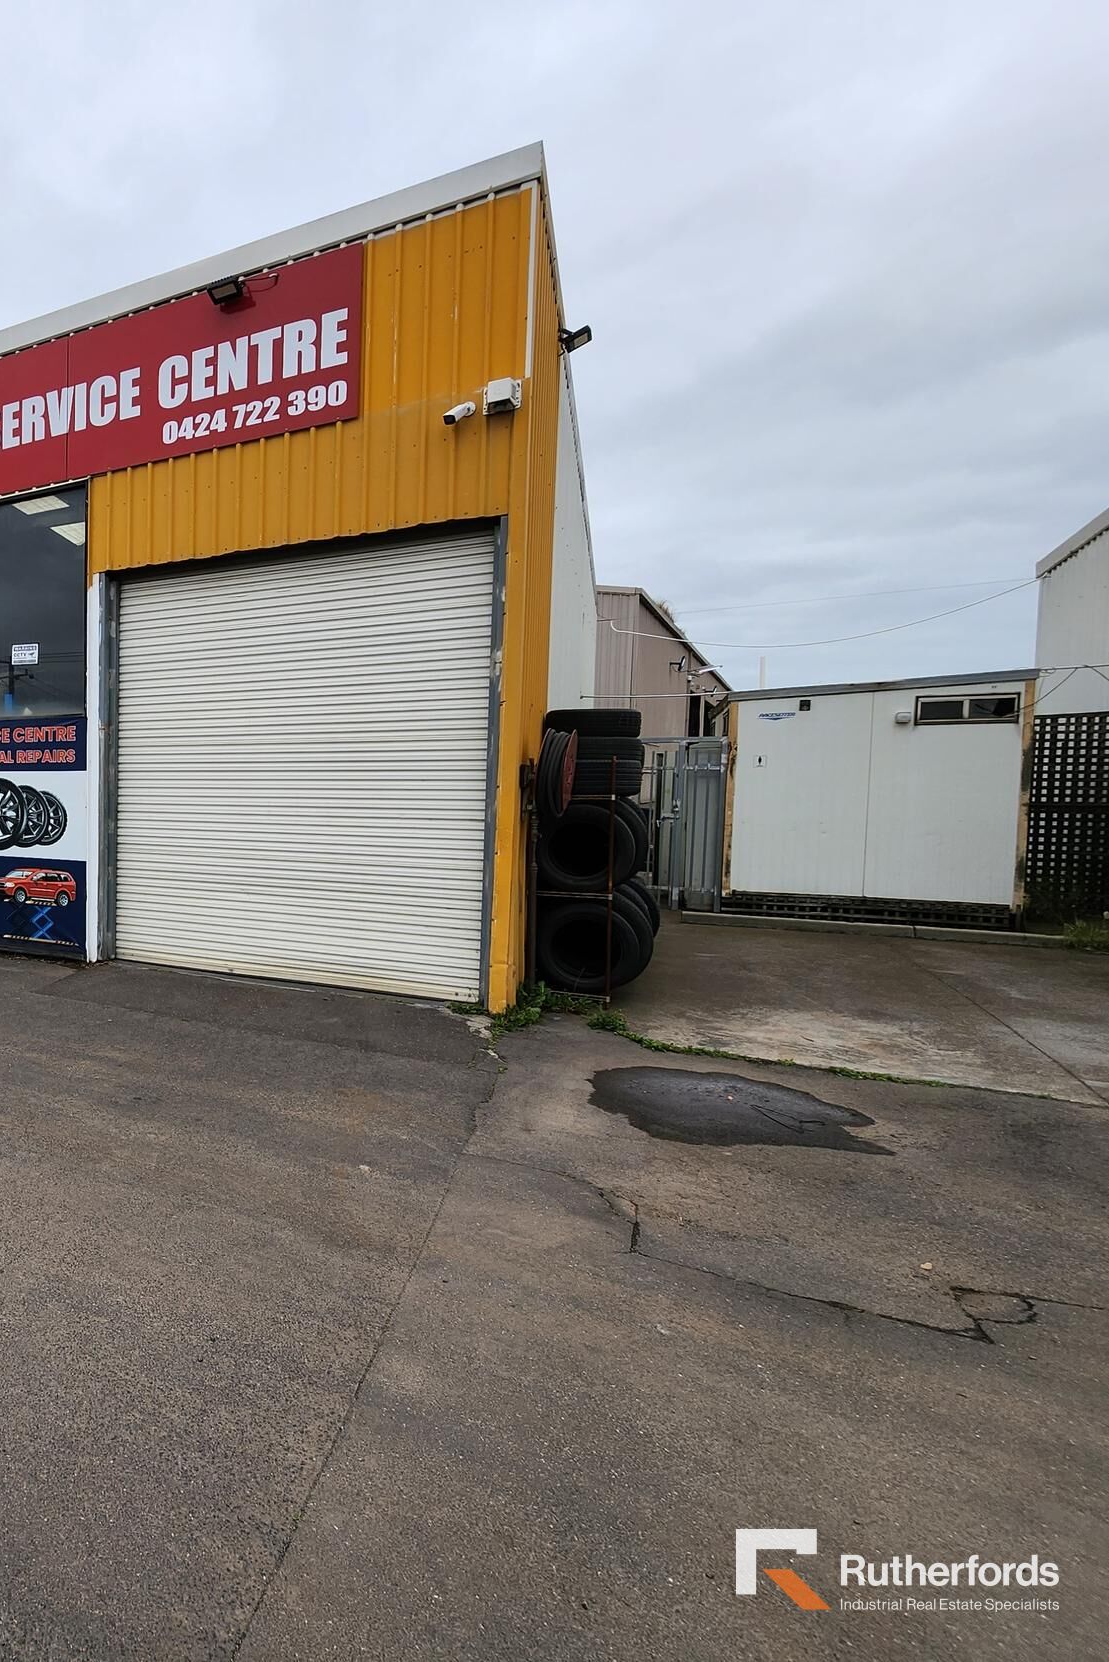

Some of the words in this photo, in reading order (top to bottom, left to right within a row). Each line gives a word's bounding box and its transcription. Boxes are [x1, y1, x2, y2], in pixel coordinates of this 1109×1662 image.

[158, 307, 349, 410] CENTRE
[162, 407, 227, 444] 0424
[232, 396, 280, 429] 722
[287, 380, 348, 416] 390
[12, 726, 77, 742] CENTRE
[16, 749, 76, 764] REPAIRS
